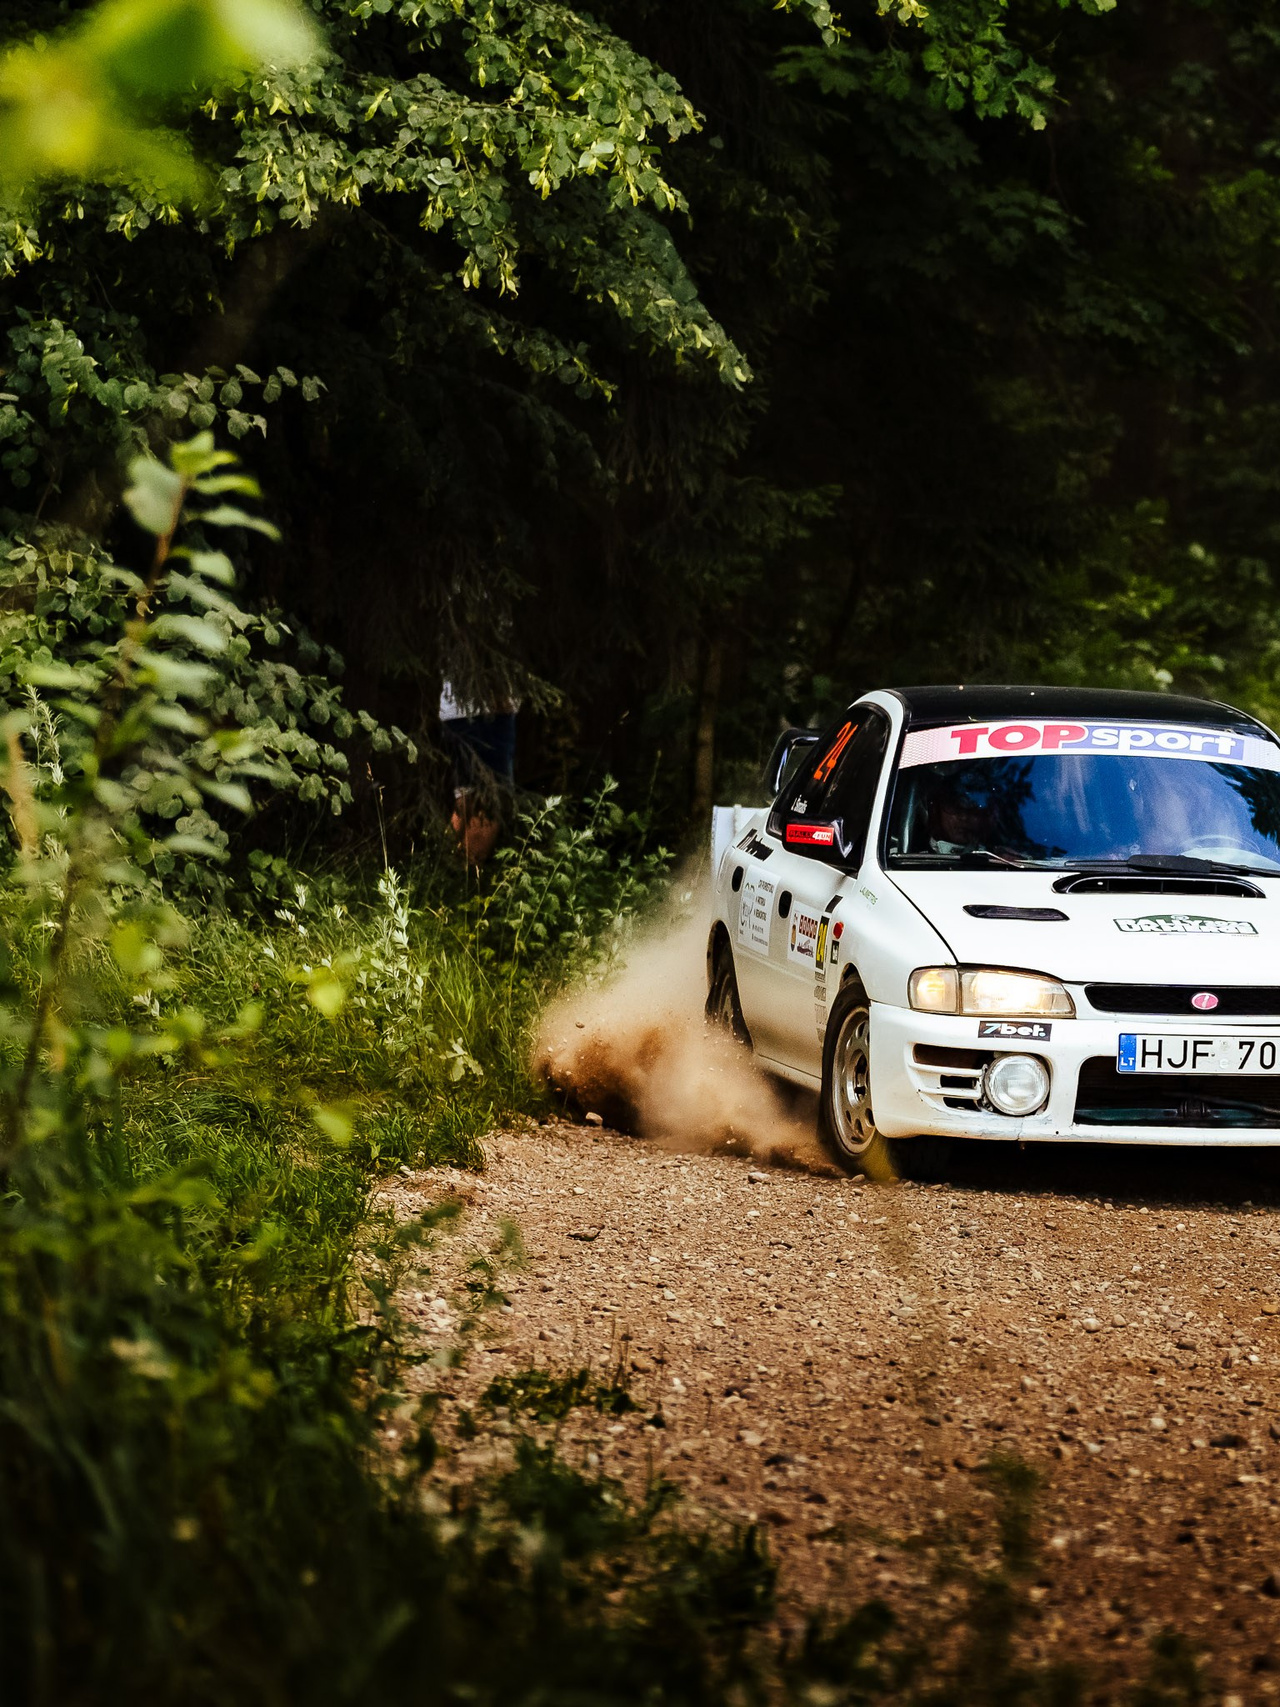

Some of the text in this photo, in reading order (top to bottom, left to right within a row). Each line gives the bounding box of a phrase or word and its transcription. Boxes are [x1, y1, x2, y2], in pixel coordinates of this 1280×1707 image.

[813, 721, 858, 783] 24
[950, 724, 1236, 755] TOPsport
[1120, 1056, 1135, 1067] LT
[1141, 1038, 1214, 1069] HJF
